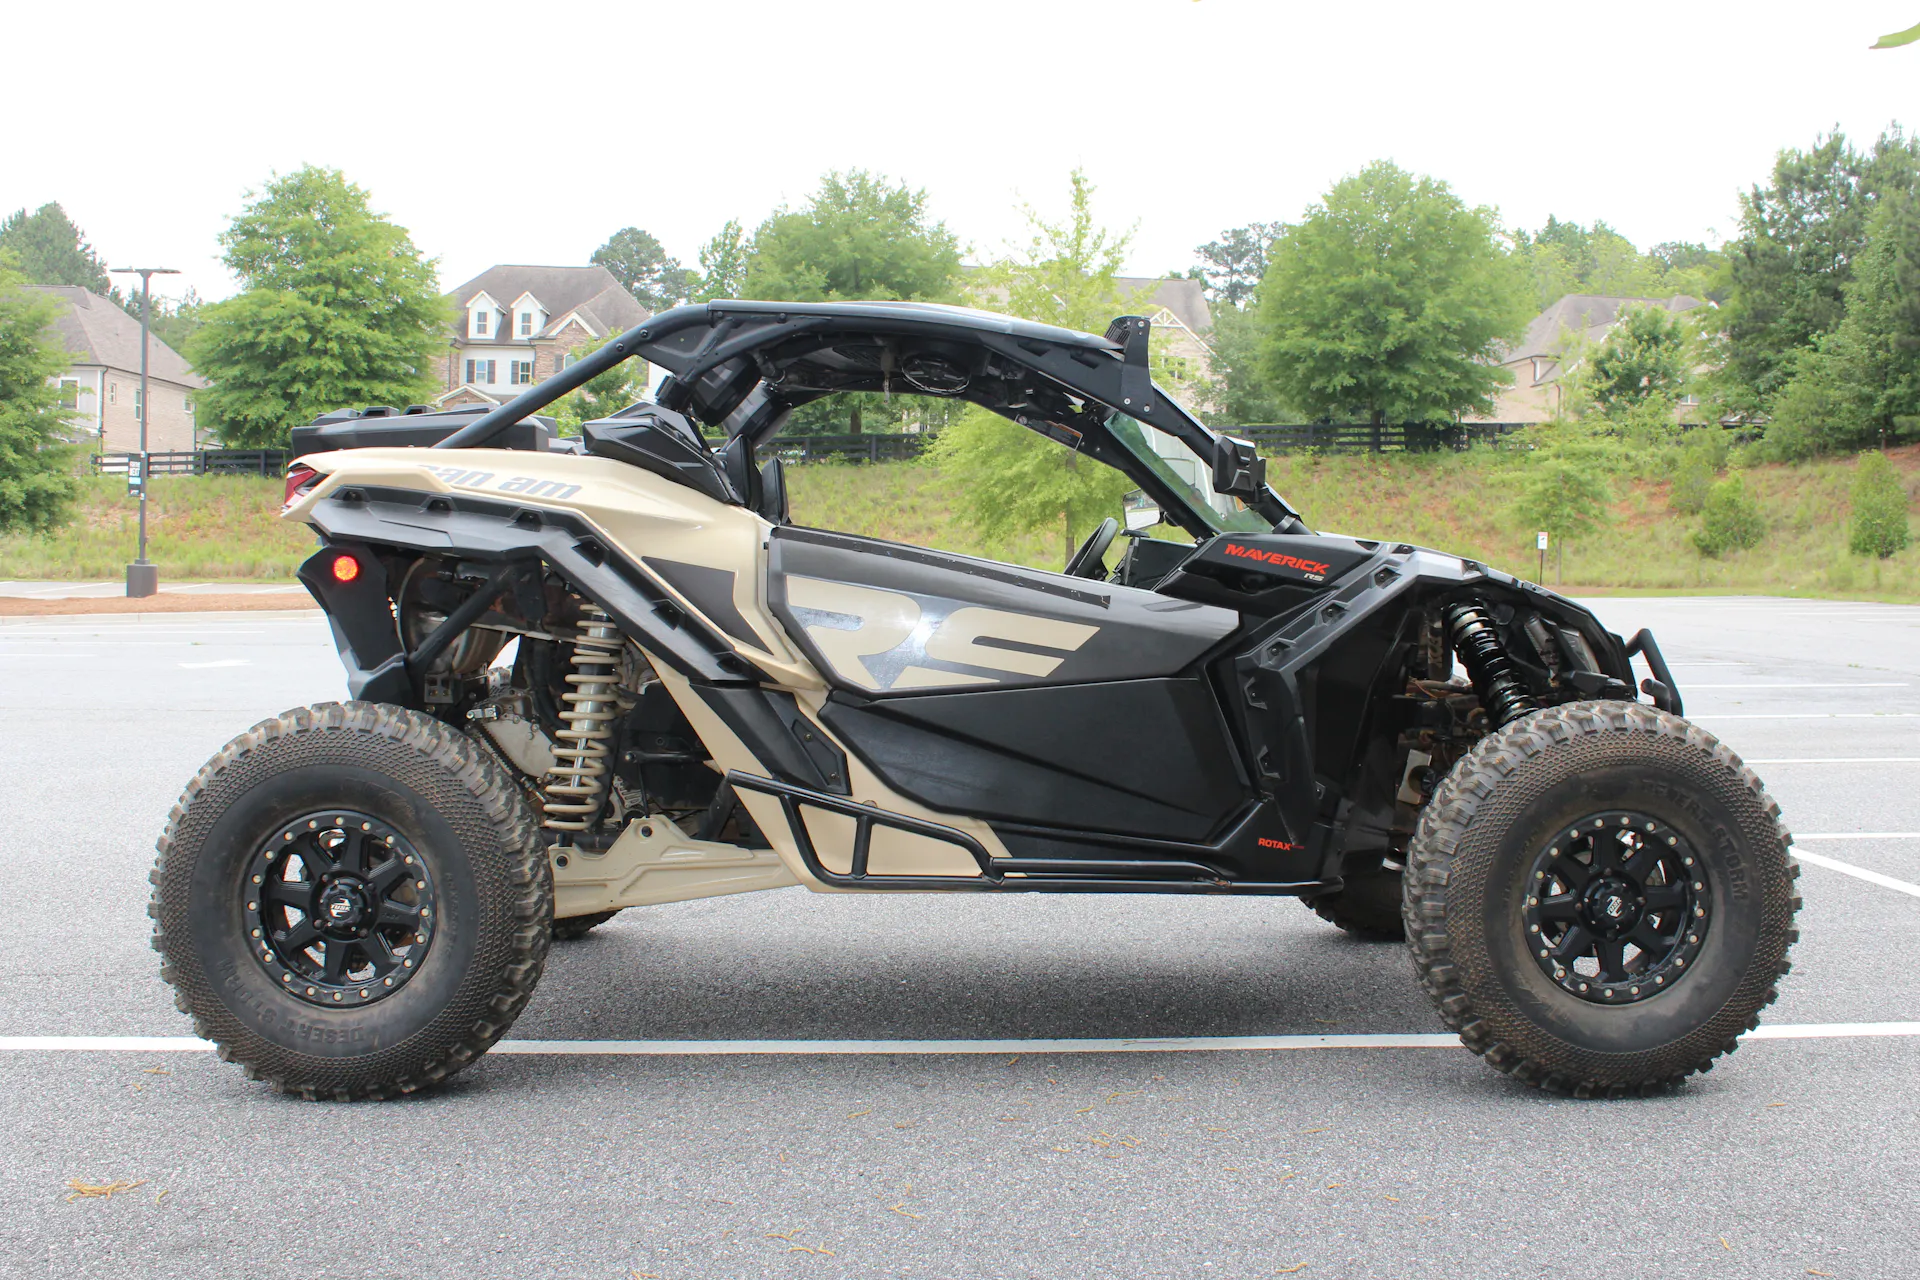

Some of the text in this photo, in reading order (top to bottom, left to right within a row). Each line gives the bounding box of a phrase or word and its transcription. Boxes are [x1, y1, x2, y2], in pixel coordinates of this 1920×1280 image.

[1224, 543, 1331, 575] MAVERICK
[1304, 572, 1324, 582] RS
[1258, 838, 1291, 851] ROTAX
[1713, 824, 1749, 900] STORM
[279, 1018, 365, 1044] DESERT
